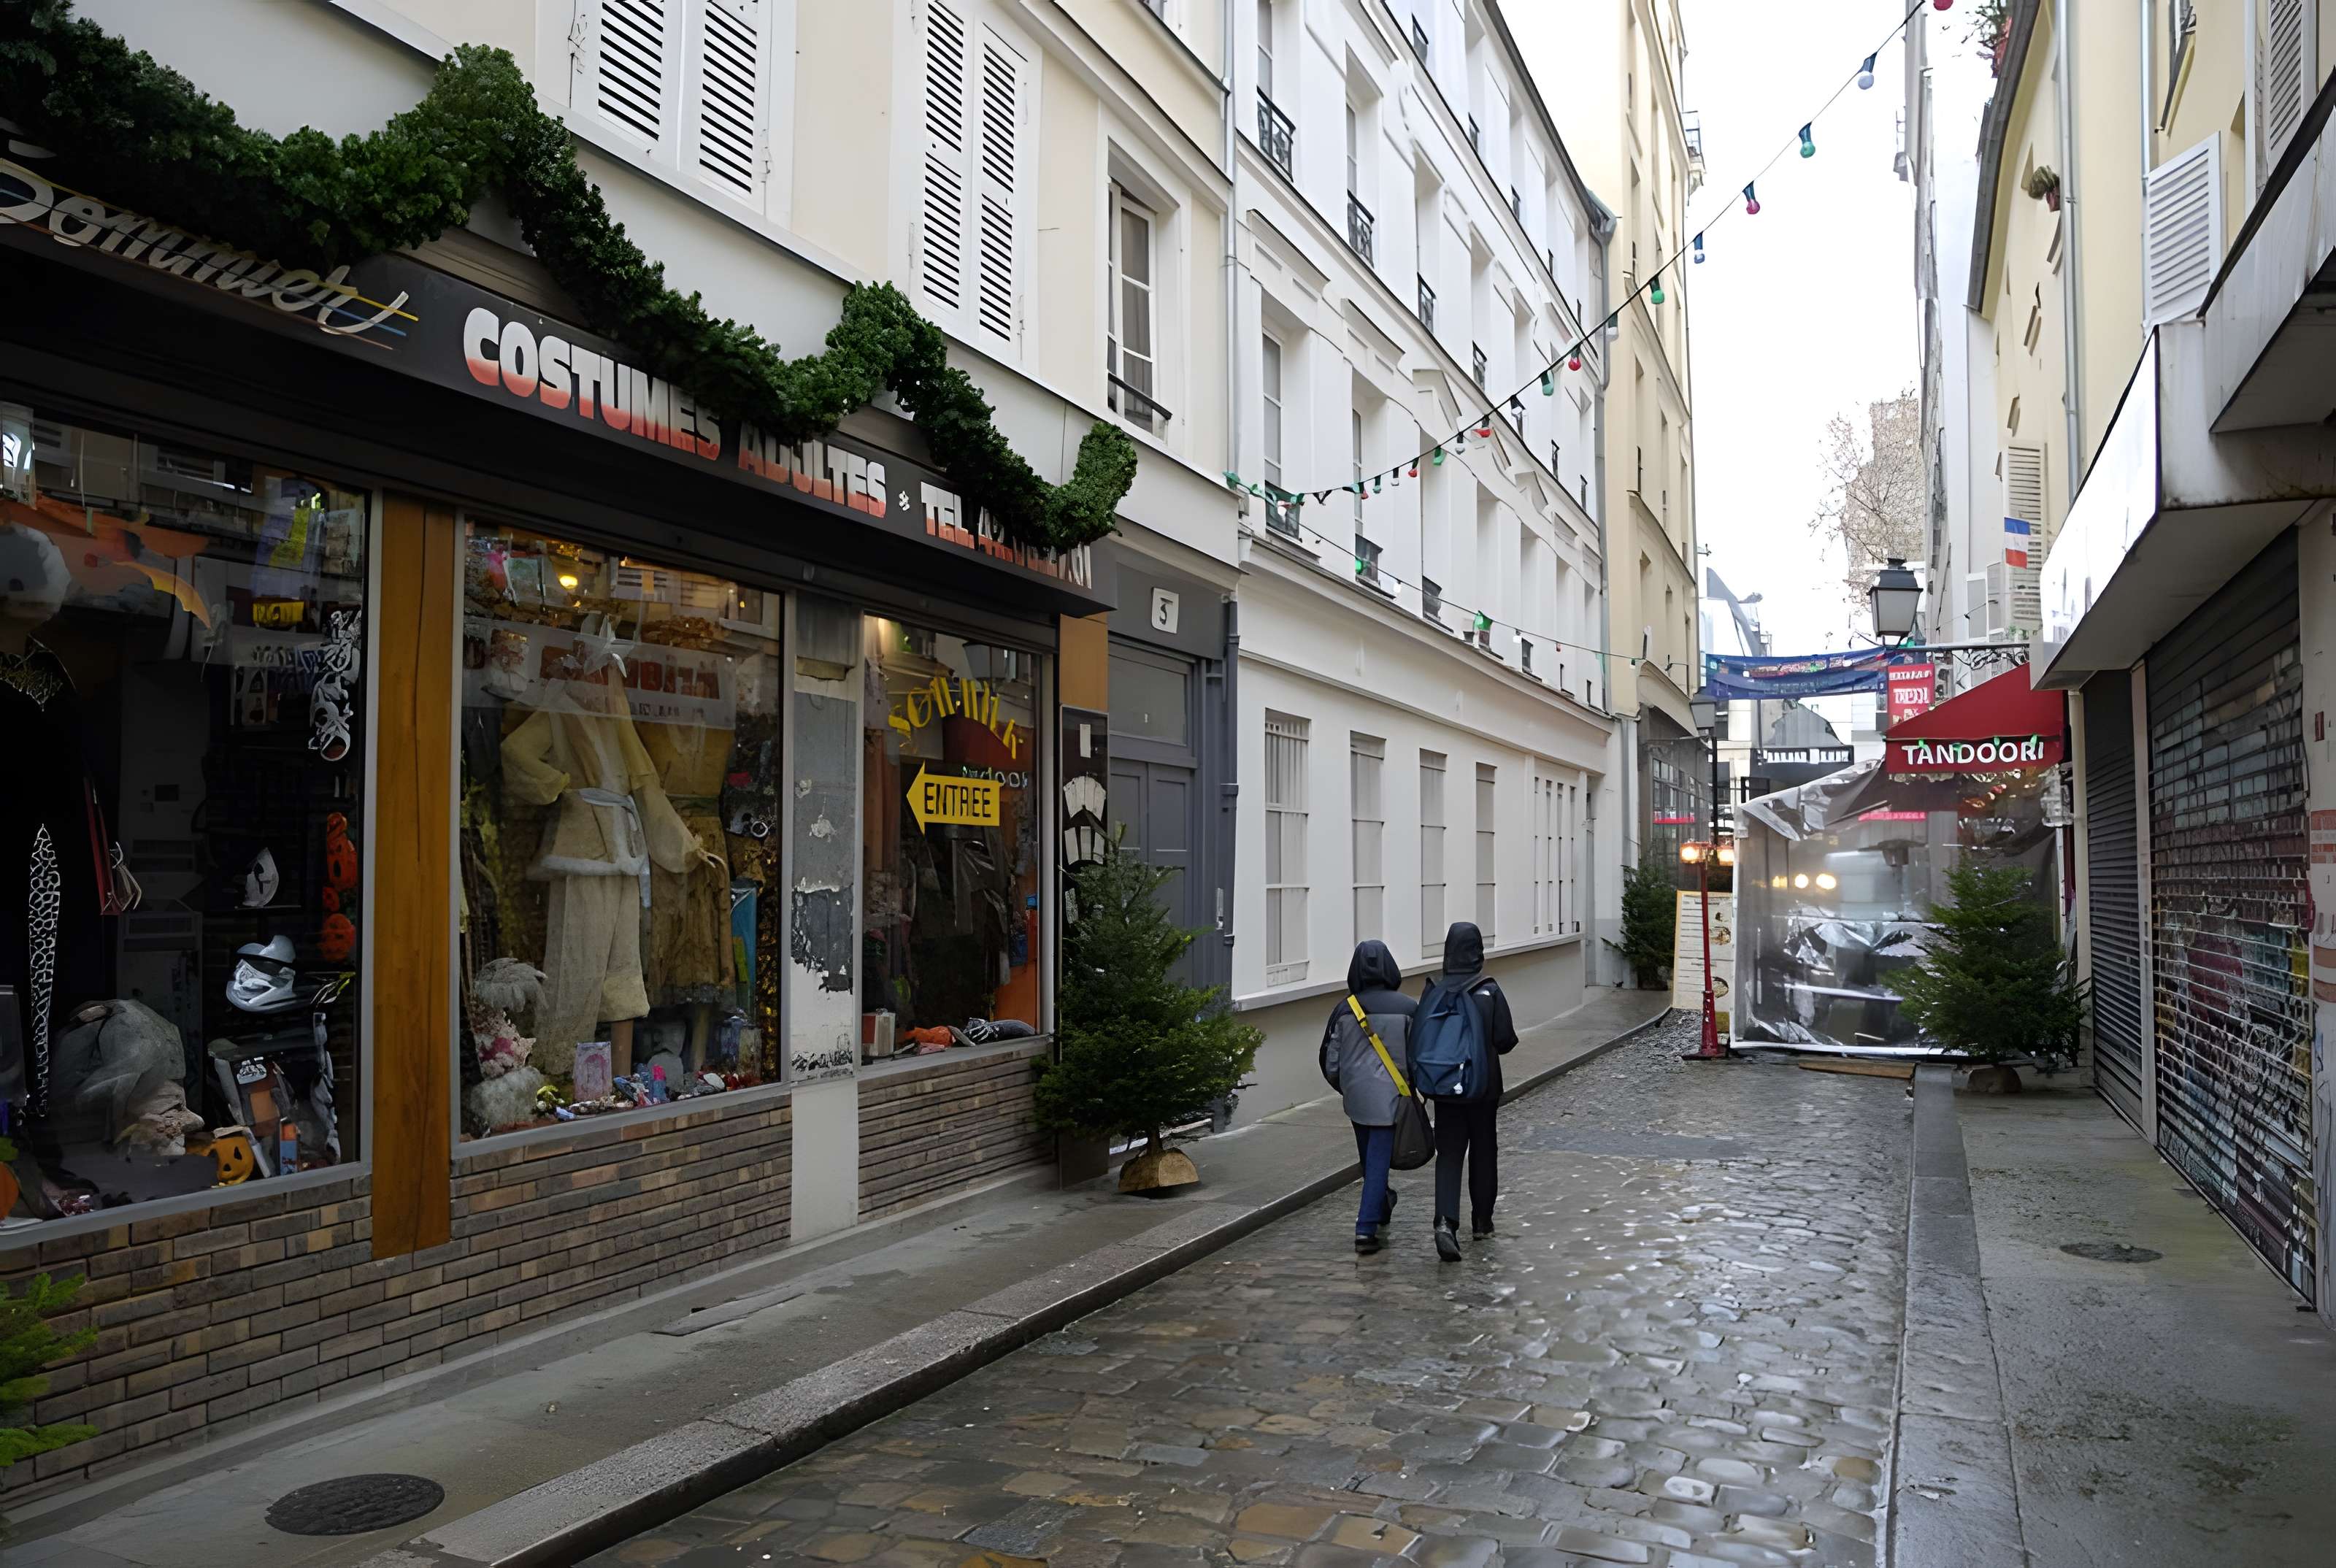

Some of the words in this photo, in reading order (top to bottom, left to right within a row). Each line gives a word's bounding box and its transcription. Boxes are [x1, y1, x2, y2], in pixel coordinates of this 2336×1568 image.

[463, 307, 721, 461] COSTUMES
[1901, 741, 2044, 765] TANDOORI
[924, 782, 991, 818] ENTREE
